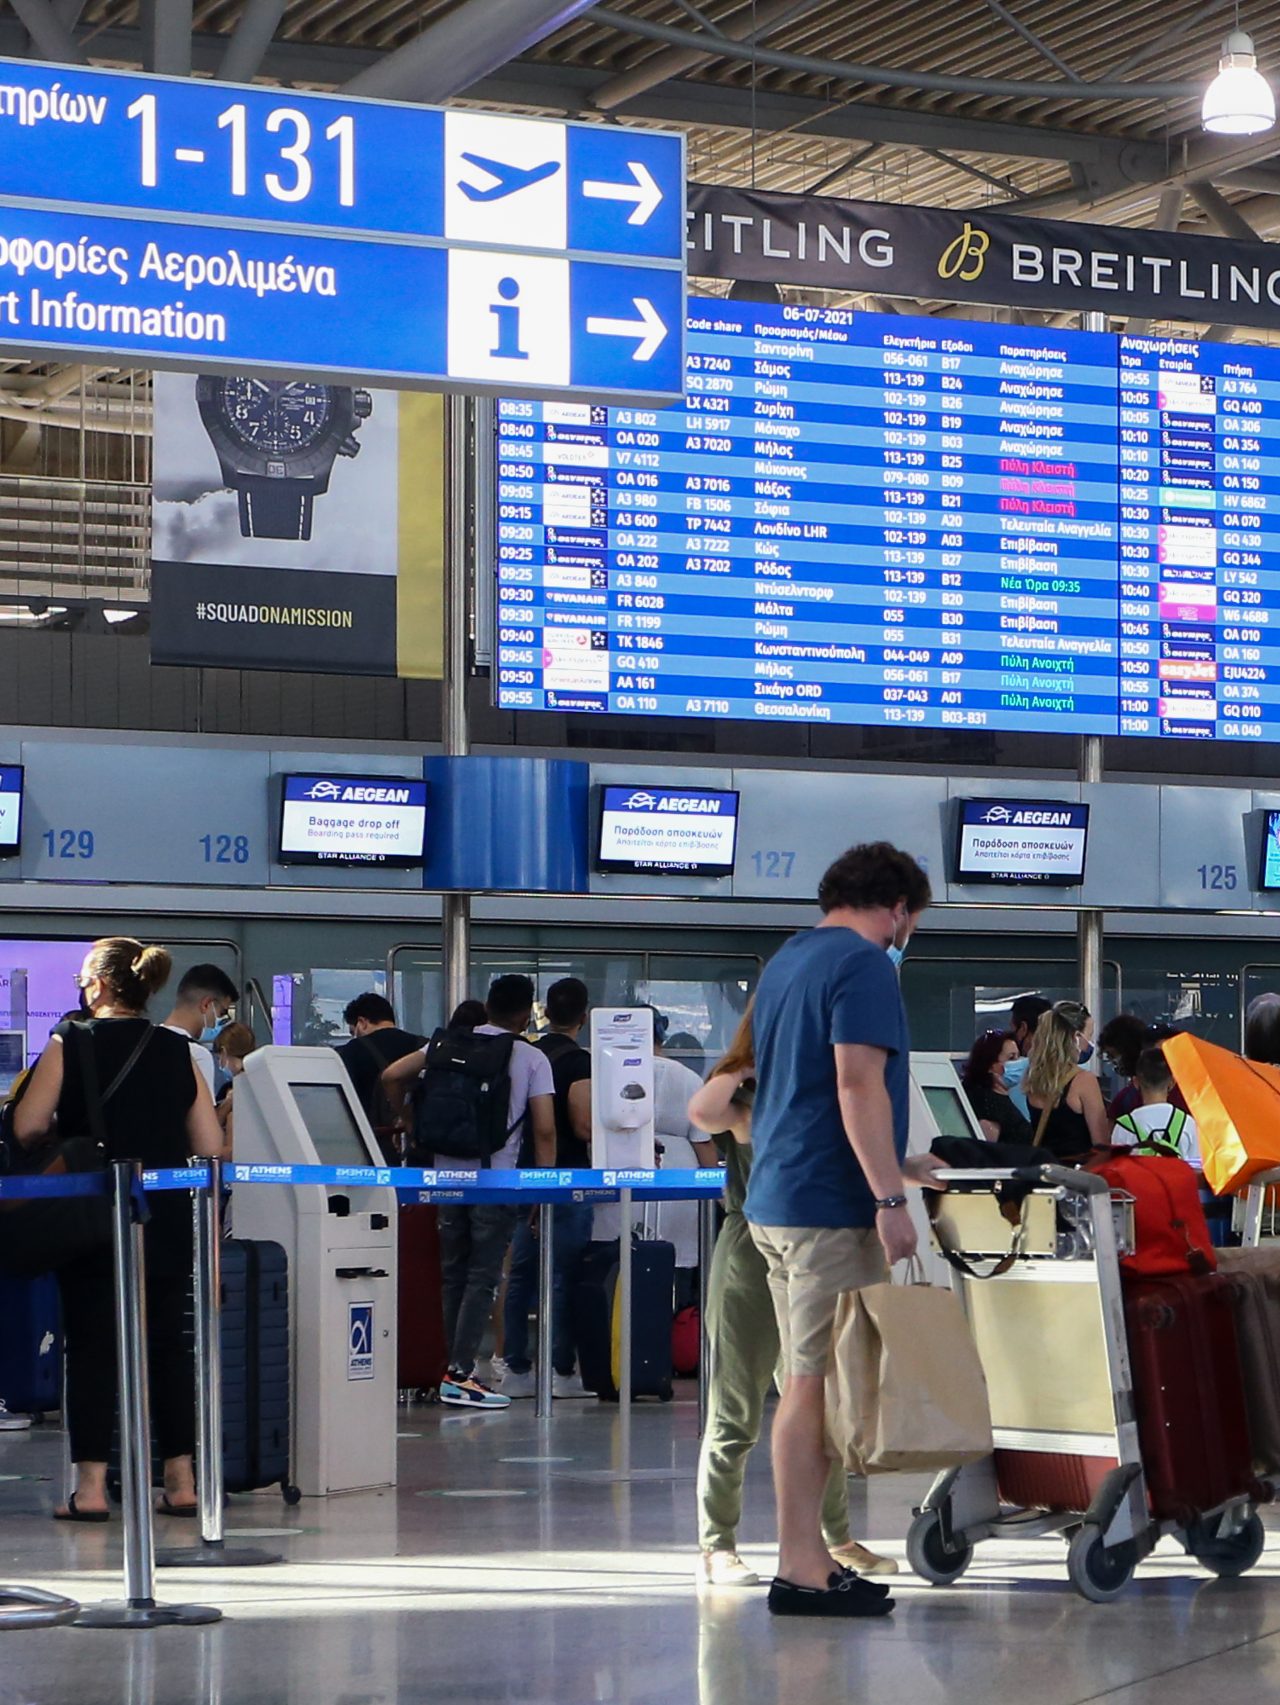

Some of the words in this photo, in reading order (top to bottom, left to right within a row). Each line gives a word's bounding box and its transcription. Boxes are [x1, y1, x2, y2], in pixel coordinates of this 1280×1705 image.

[127, 94, 354, 207] 1-131
[139, 242, 337, 297] Αερολιμένα
[31, 289, 226, 342] Information
[686, 318, 711, 329] Code
[714, 321, 741, 331] share
[784, 307, 852, 324] 06-07-2021
[1121, 430, 1148, 442] 10:10
[1223, 437, 1239, 450] OA
[1241, 439, 1260, 451] 354
[500, 547, 532, 560] 09:25
[617, 553, 635, 566] OA
[637, 555, 658, 568] 202
[686, 558, 701, 570] A3
[703, 558, 730, 572] 7202
[754, 561, 792, 579] Ρόδος
[883, 570, 925, 583] 113-139
[941, 572, 962, 586] B12
[1001, 576, 1022, 589] Νέα
[1025, 578, 1049, 593] Ώρα
[1051, 580, 1081, 593] 09:35
[196, 602, 353, 628] #SQUADONAMISSION
[500, 629, 533, 642] 09:40
[617, 635, 632, 647] TK
[636, 636, 663, 649] 1846
[755, 643, 864, 661] Κωνσταντινούπολη
[883, 649, 929, 662] 044-049
[941, 651, 964, 664] A09
[1001, 654, 1029, 670] Πύλη
[1031, 656, 1074, 673] Ανοιχτή
[1121, 661, 1149, 673] 10:50
[1224, 666, 1265, 679] EJU4224
[500, 670, 533, 683] 09:50
[617, 676, 633, 688] AA
[635, 676, 654, 689] 161
[754, 681, 794, 698] Σικάγο
[795, 684, 822, 697] ORD
[883, 688, 928, 702] 037-043
[941, 691, 962, 704] A01
[1001, 693, 1029, 709] Πύλη
[1031, 695, 1074, 711] Ανοιχτή
[342, 786, 409, 803] AEGEAN
[657, 797, 720, 813] AEGEAN
[309, 816, 355, 829] Baggage
[358, 818, 382, 830] drop
[385, 819, 400, 830] off
[1012, 811, 1072, 825] AEGEAN
[42, 829, 94, 859] 129
[199, 834, 250, 863] 128
[972, 837, 1019, 851] Παράδοση
[751, 850, 796, 879] 127
[1196, 865, 1237, 890] 125
[250, 1166, 293, 1175] ATHENS
[438, 1170, 478, 1179] ATHENS
[617, 1171, 655, 1180] ATHENS
